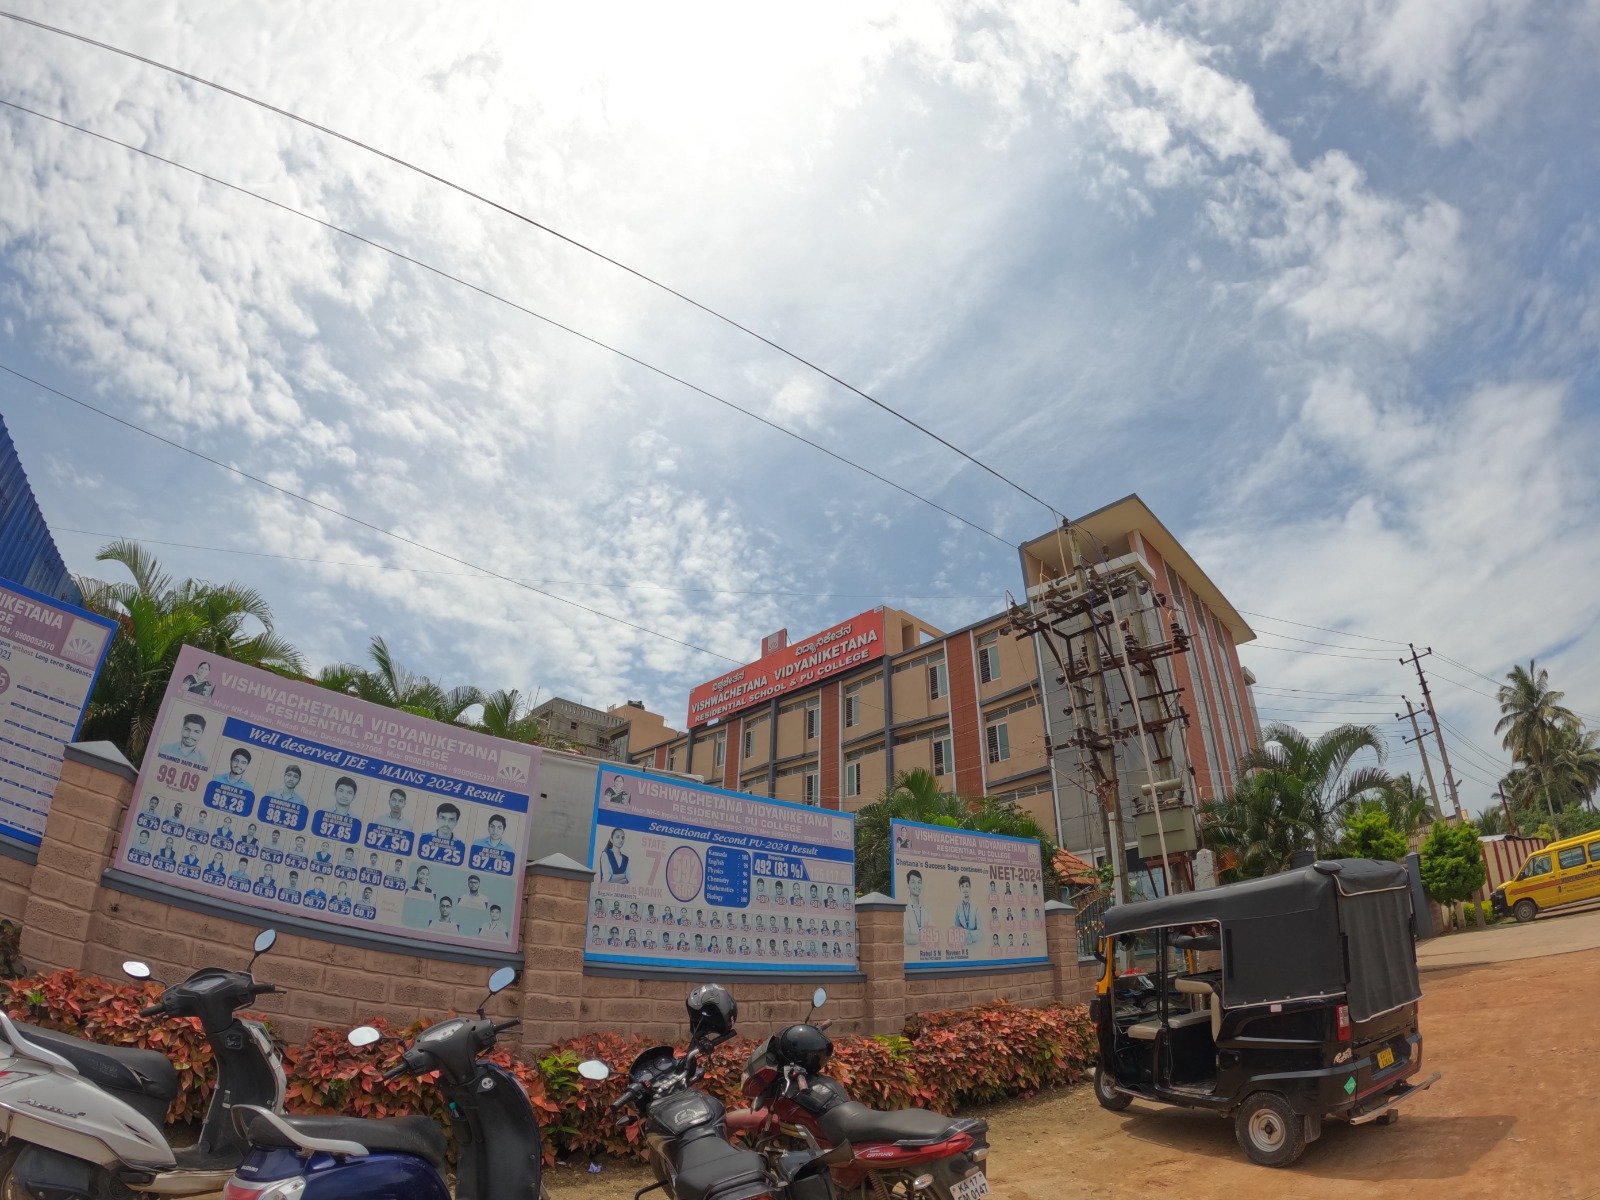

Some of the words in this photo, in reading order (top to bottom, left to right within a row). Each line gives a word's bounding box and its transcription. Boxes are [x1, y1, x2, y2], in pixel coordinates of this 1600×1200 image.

[0, 591, 64, 630] IKETANA
[691, 676, 768, 714] VISHWACHETANA
[774, 629, 878, 681] VIDYANIKETANA
[694, 698, 747, 723] RESIDENTIAL
[748, 684, 787, 702] SCHOOL
[789, 678, 798, 686] &
[800, 672, 814, 683] PU
[817, 650, 870, 676] COLLEGE
[221, 672, 365, 728] VISHWACHETANA
[371, 717, 498, 763] VIDYANIKETANA
[266, 703, 359, 738] RESIDENTIAL
[364, 731, 384, 745] PU
[387, 738, 450, 763] COLLEGE
[249, 728, 280, 746] Well
[280, 737, 343, 763] deserved
[340, 755, 369, 770] JEE
[378, 764, 427, 784] MAINS
[426, 776, 463, 794] 2024
[463, 785, 506, 803] Result
[156, 764, 201, 792] 99.09
[211, 793, 245, 813] 98.28
[637, 781, 743, 814] VISHWACHETANA
[746, 803, 829, 828] VIDYANIKETANA
[265, 808, 298, 827] 98.38
[672, 804, 741, 824] RESIDENTIAL
[745, 816, 758, 827] PU
[761, 820, 802, 833] COLLEGE
[319, 822, 352, 840] 97.85
[648, 822, 711, 840] Sensational
[712, 832, 746, 846] Second
[748, 838, 789, 852] PU-2024
[791, 845, 818, 856] Result
[366, 831, 411, 852] 97.50
[641, 837, 666, 850] STATE
[915, 830, 977, 848] VISHWACHETANA
[979, 839, 1026, 853] VIDYANIKETANA
[936, 844, 976, 856] RESIDENTIAL
[977, 849, 986, 857] PU
[987, 851, 1011, 859] COLLEGE
[420, 844, 461, 863] 97.25
[472, 854, 511, 873] 97.09
[754, 859, 771, 875] 492
[774, 861, 788, 877] (83
[790, 863, 803, 878] %)
[989, 865, 1041, 882] NEET-2024
[638, 887, 662, 898] RANK
[957, 1181, 970, 1193] KA
[970, 1176, 978, 1186] 17
[971, 1183, 988, 1199] 0147
